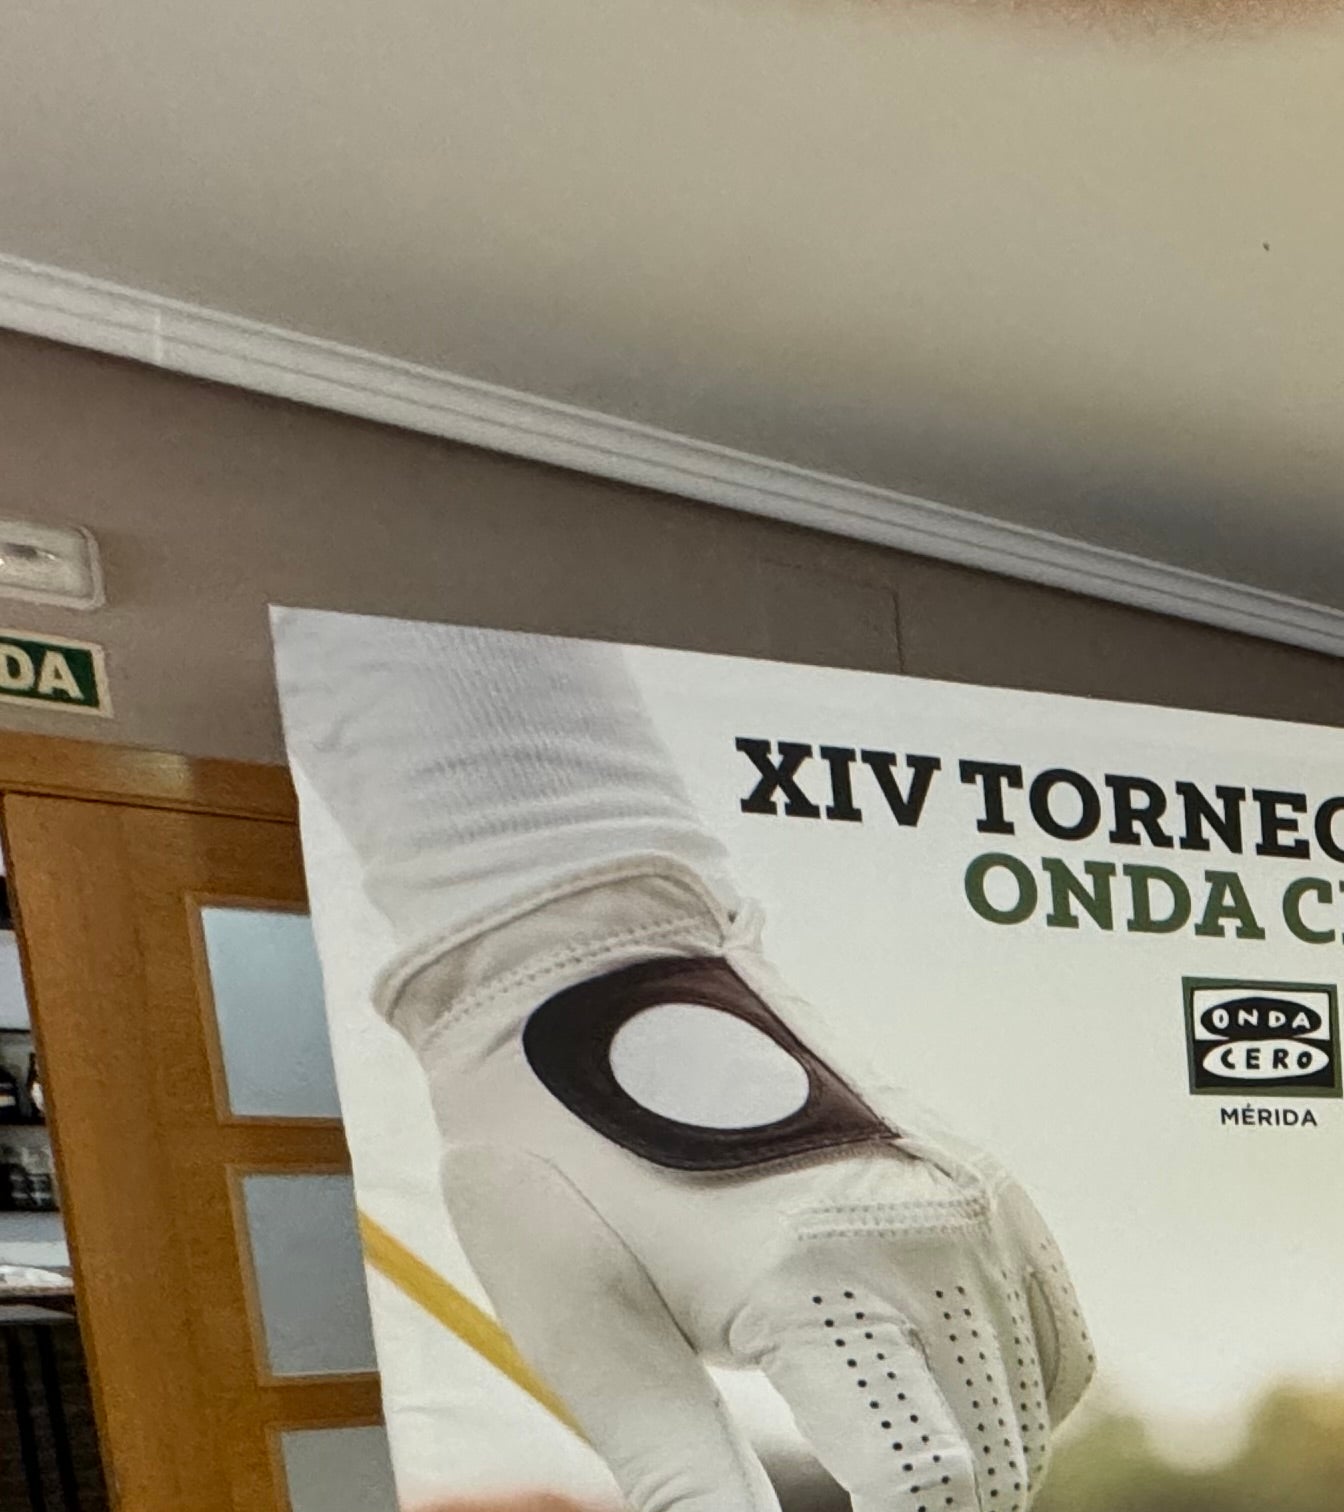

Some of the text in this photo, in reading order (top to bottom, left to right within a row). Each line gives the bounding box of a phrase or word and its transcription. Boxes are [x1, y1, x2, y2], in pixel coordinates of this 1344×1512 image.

[735, 737, 941, 827] XIV
[964, 852, 1265, 940] ONDA
[1212, 1006, 1312, 1030] ONDA
[1220, 1047, 1313, 1070] CERO
[1220, 1106, 1318, 1127] MÉRIDA
